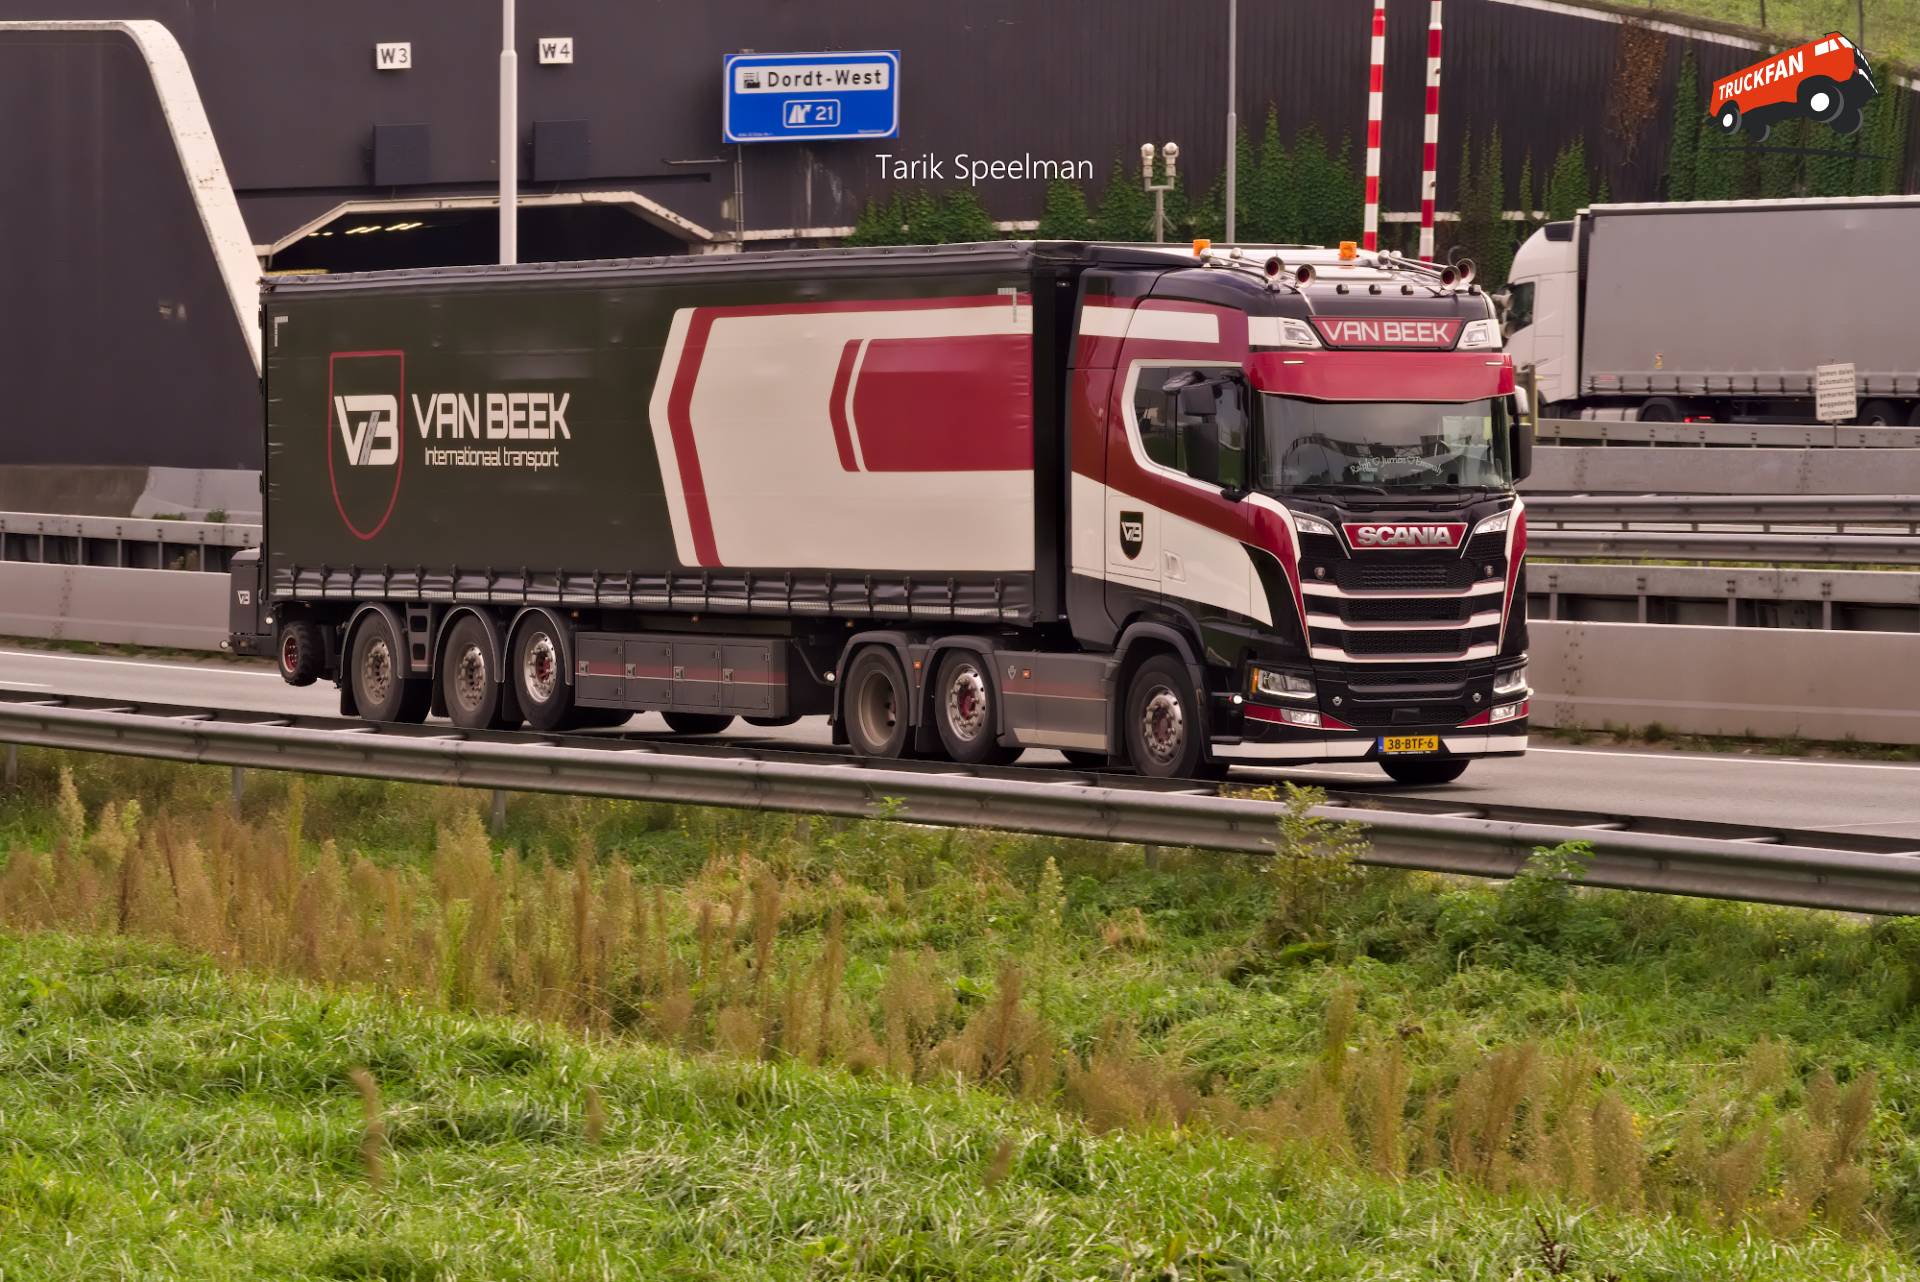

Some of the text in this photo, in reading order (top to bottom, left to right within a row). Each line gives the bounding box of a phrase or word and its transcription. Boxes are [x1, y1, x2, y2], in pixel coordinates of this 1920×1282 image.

[380, 47, 408, 64] W3
[767, 69, 882, 88] Dordt-West
[815, 105, 834, 121] 21
[1321, 320, 1450, 343] VAN BEEK
[411, 393, 571, 440] VAN BEEK
[424, 446, 560, 472] Internationaal transport
[1356, 526, 1453, 546] SCANIA
[1387, 738, 1434, 750] 38-BTF-6
